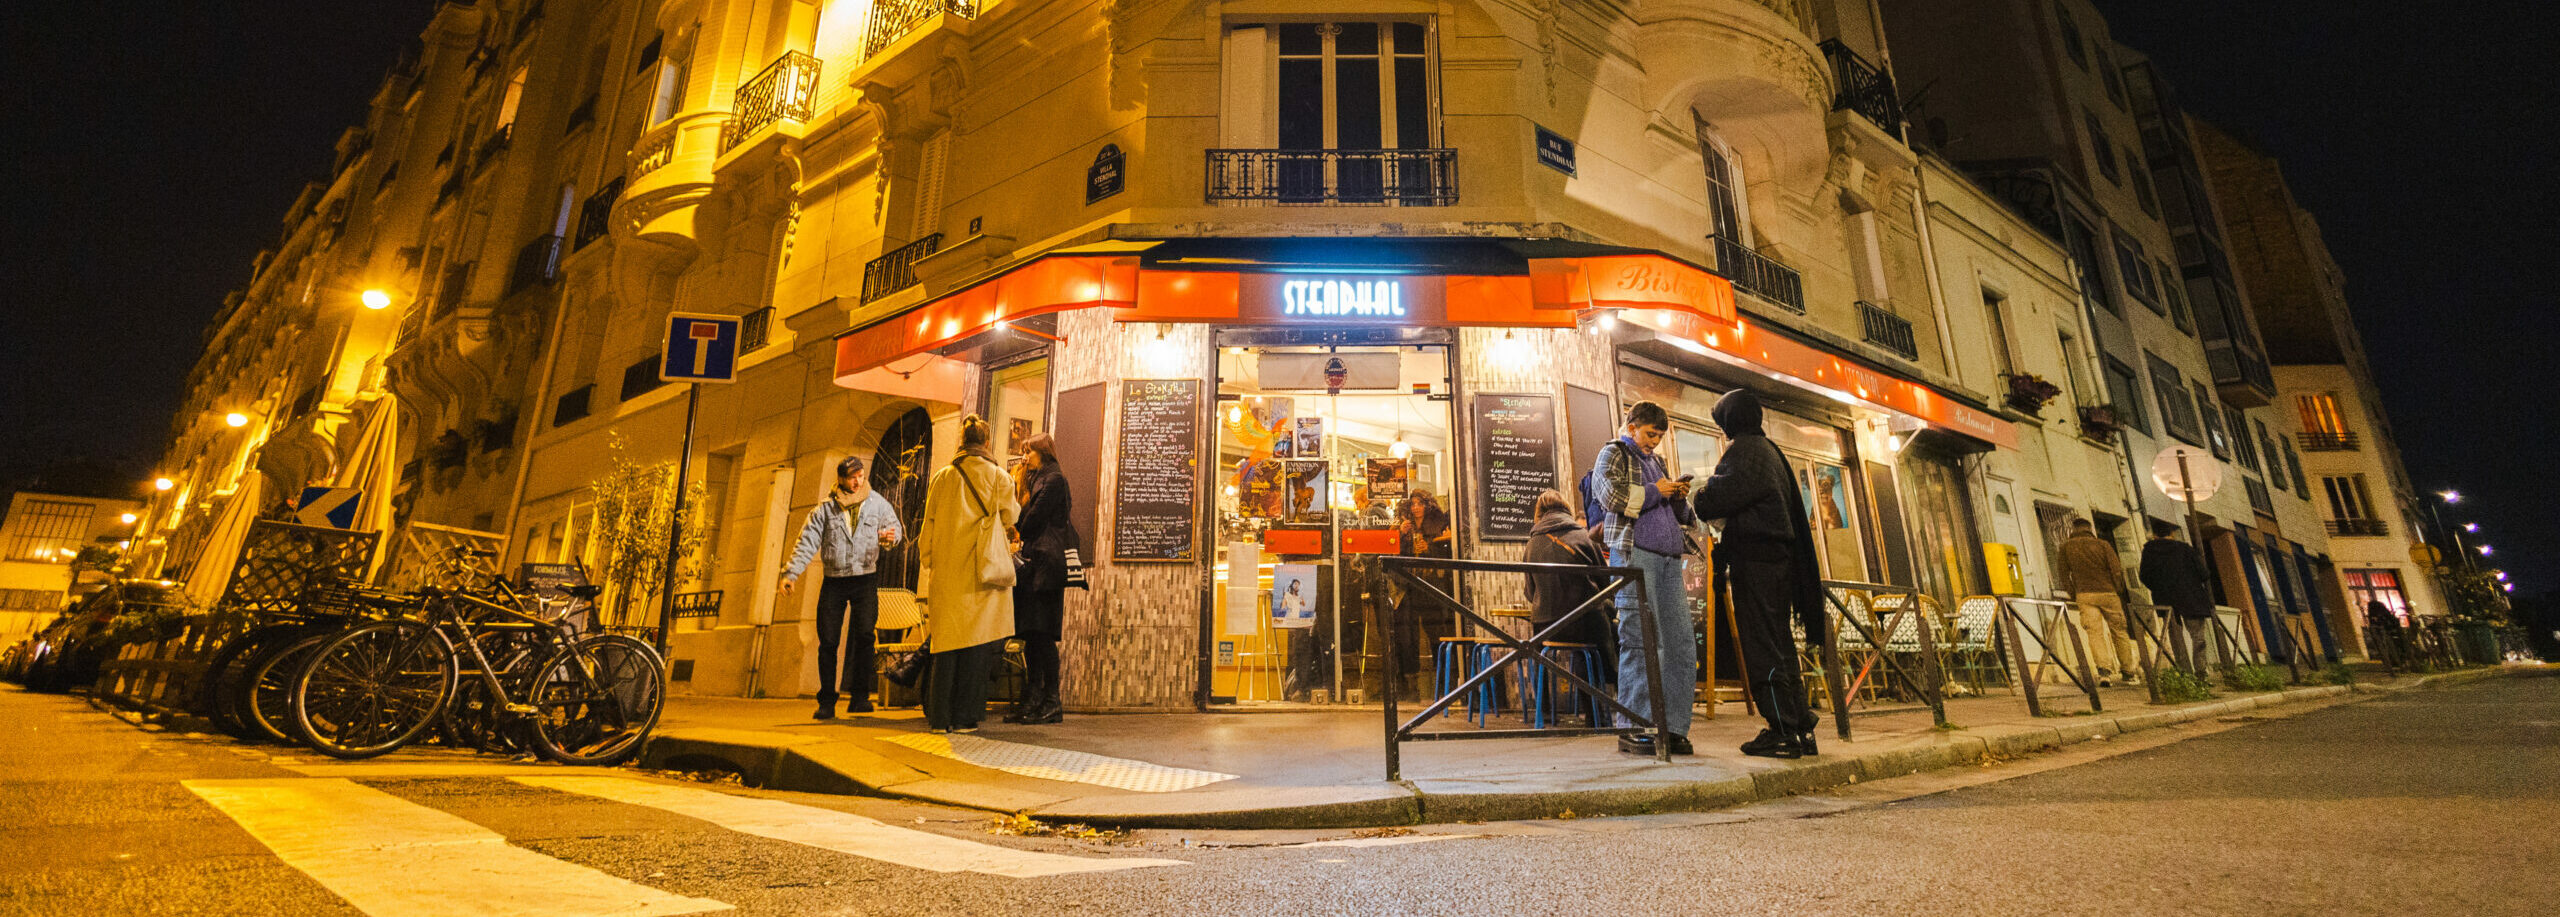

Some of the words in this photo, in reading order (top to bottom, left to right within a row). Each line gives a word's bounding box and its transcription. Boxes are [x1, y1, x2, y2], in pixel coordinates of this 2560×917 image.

[1549, 139, 1563, 152] RUE
[1540, 147, 1575, 170] STENDHAL
[1283, 279, 1406, 317] STENDHAL
